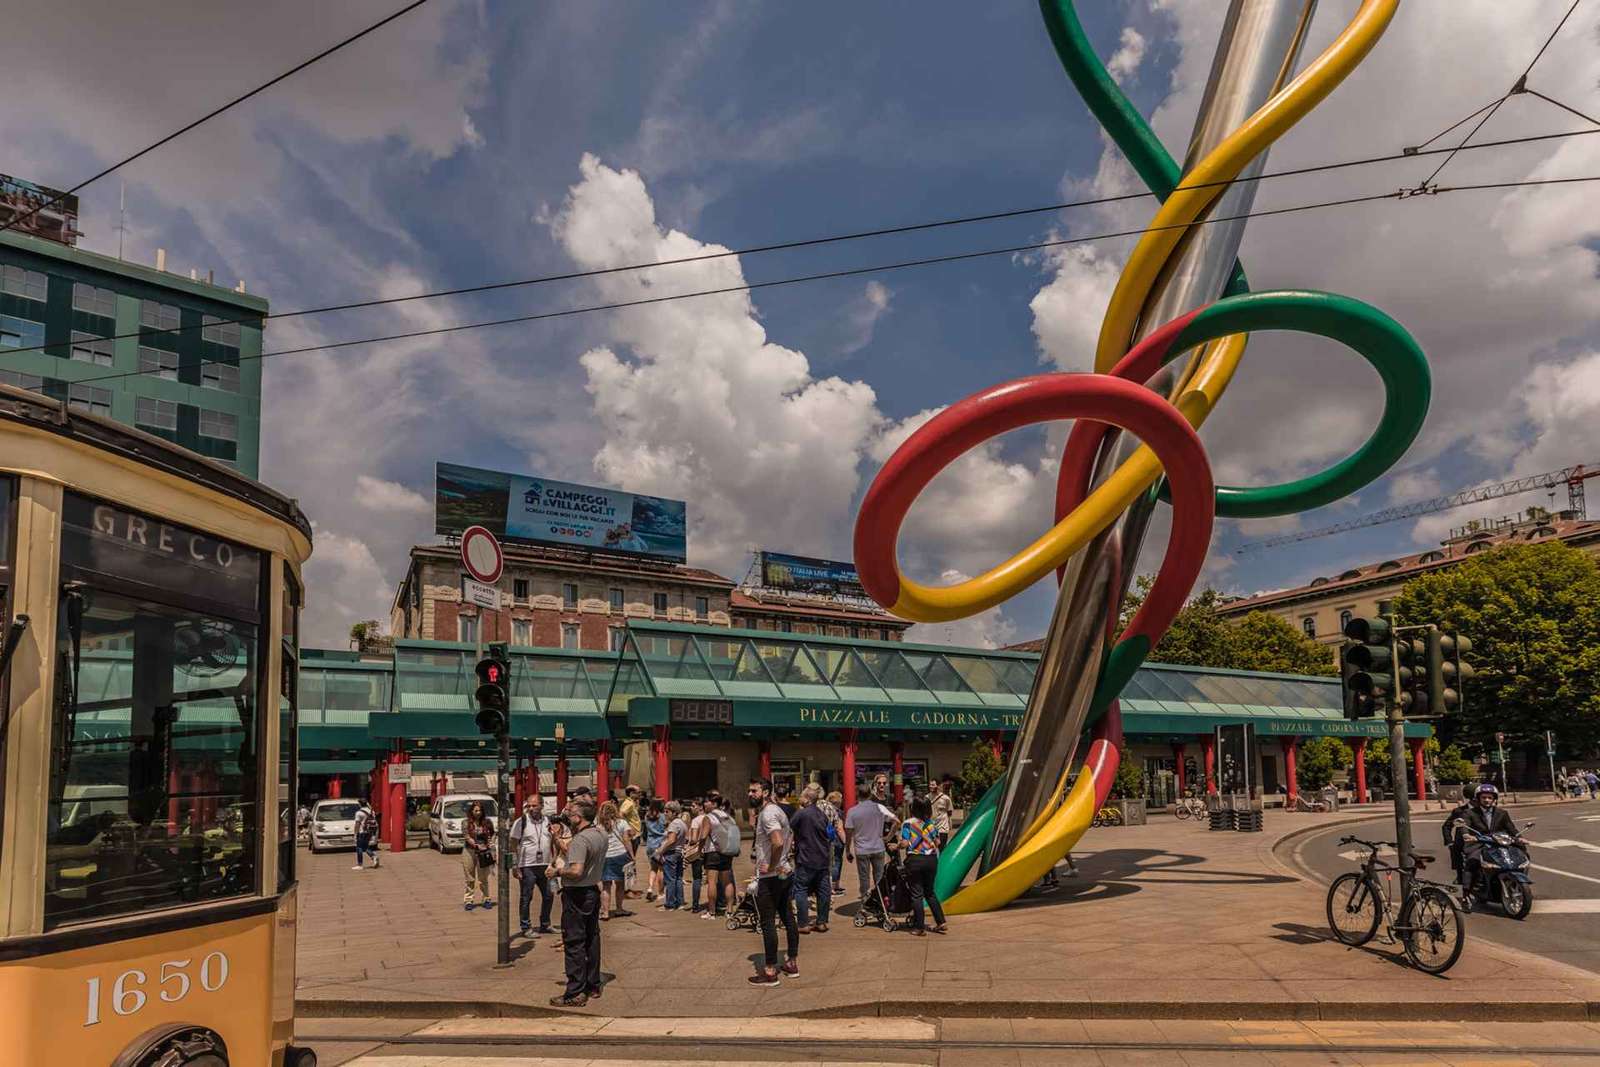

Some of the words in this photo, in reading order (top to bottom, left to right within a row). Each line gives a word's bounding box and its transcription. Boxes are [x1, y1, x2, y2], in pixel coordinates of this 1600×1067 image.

[545, 488, 609, 506] CAMPEGGI
[94, 505, 233, 568] GRECO
[800, 707, 891, 723] PIAZZALE
[911, 711, 989, 726] CADORNA
[1271, 722, 1313, 733] PIAZZALE
[1321, 722, 1360, 734] CADORNA
[83, 951, 230, 1027] 1650
